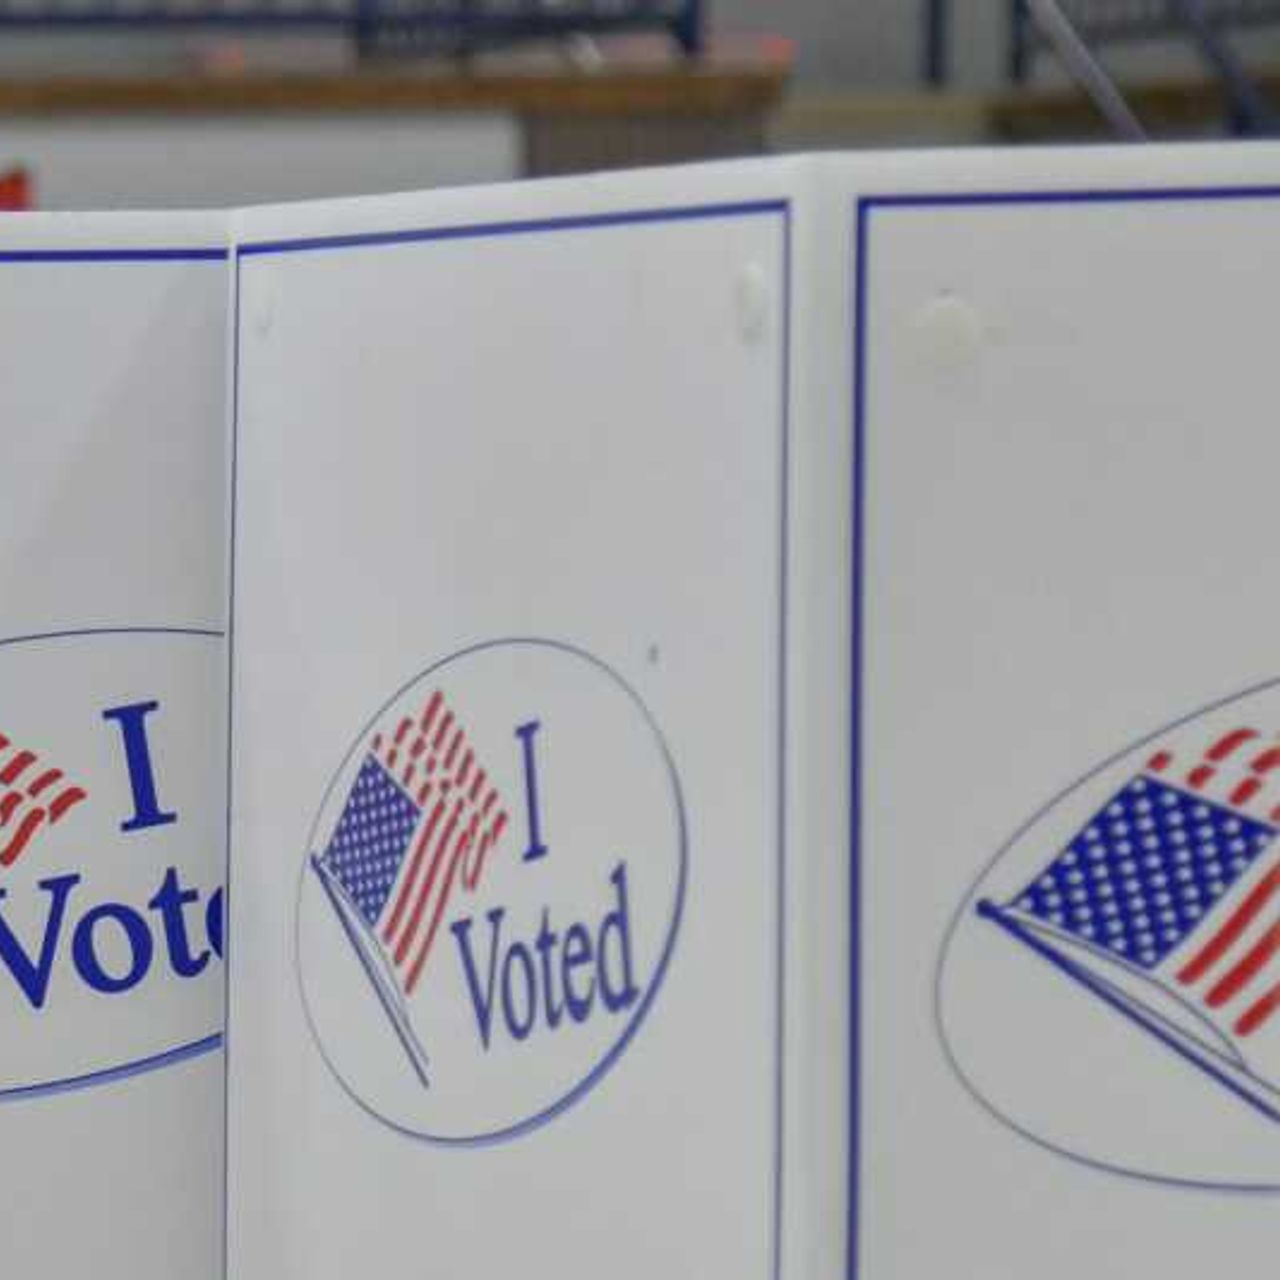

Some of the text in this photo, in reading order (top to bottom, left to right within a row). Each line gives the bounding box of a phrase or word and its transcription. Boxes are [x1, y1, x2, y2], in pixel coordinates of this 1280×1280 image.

[102, 700, 177, 832] I
[514, 720, 548, 862] I
[450, 860, 639, 1052] Voted
